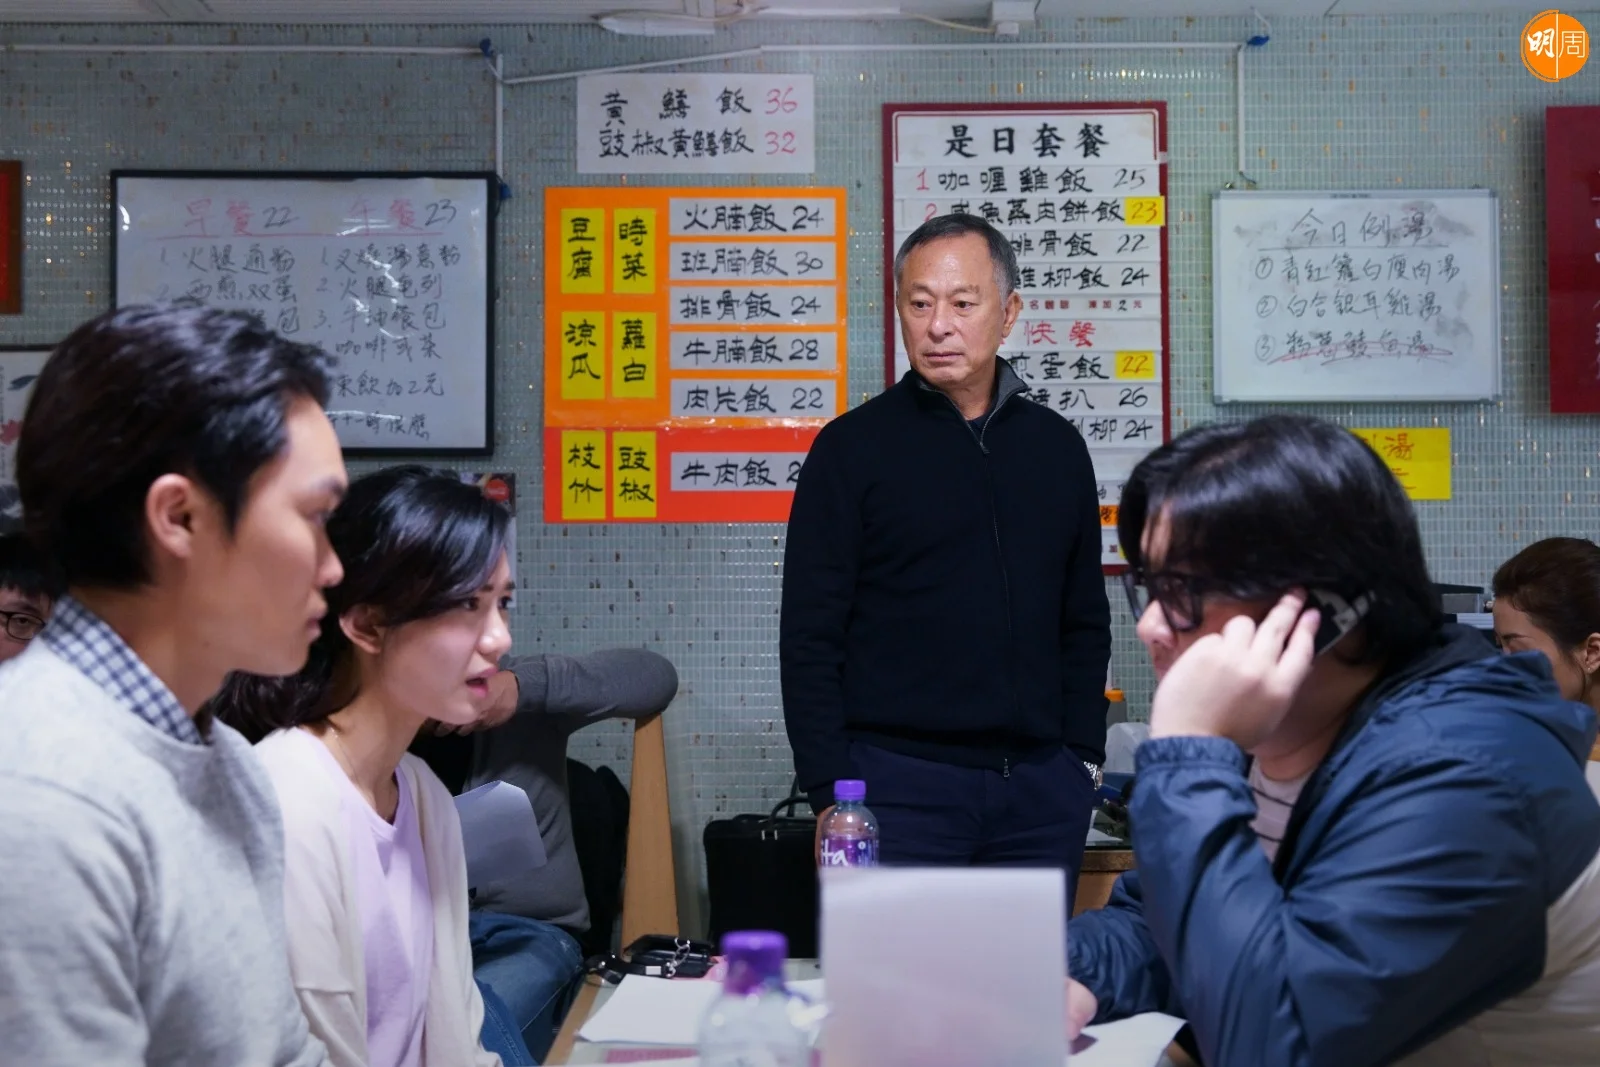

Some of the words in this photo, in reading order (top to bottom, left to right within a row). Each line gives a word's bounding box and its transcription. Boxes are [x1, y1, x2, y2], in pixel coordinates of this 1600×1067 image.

[765, 87, 797, 115] 36
[765, 131, 797, 155] 32
[944, 122, 1109, 159] 是日套餐
[916, 168, 930, 191] 1
[1113, 168, 1147, 190] 25
[262, 206, 300, 228] 22
[425, 198, 457, 227] 23
[683, 204, 787, 232] 火腩飯
[792, 205, 824, 231] 24
[1132, 201, 1158, 223] 23
[1291, 208, 1433, 247] 今日例湯
[568, 217, 595, 280] 豆腐
[619, 216, 647, 281] 時菜
[1116, 233, 1149, 255] 22
[795, 251, 823, 273] 30
[1121, 267, 1149, 288] 24
[680, 289, 780, 320] 排骨飯
[791, 296, 821, 316] 24
[1000, 320, 1096, 347] 快餐
[565, 319, 600, 379] 涼瓜
[683, 334, 783, 365] 牛腩飯
[789, 339, 819, 361] 28
[1122, 355, 1152, 374] 22
[683, 384, 776, 413] 肉片飯
[791, 388, 823, 409] 22
[1119, 387, 1148, 408] 26
[1124, 419, 1153, 440] 24
[568, 442, 602, 503] 枝竹
[681, 457, 776, 486] 牛肉飯
[786, 461, 801, 484] 2
